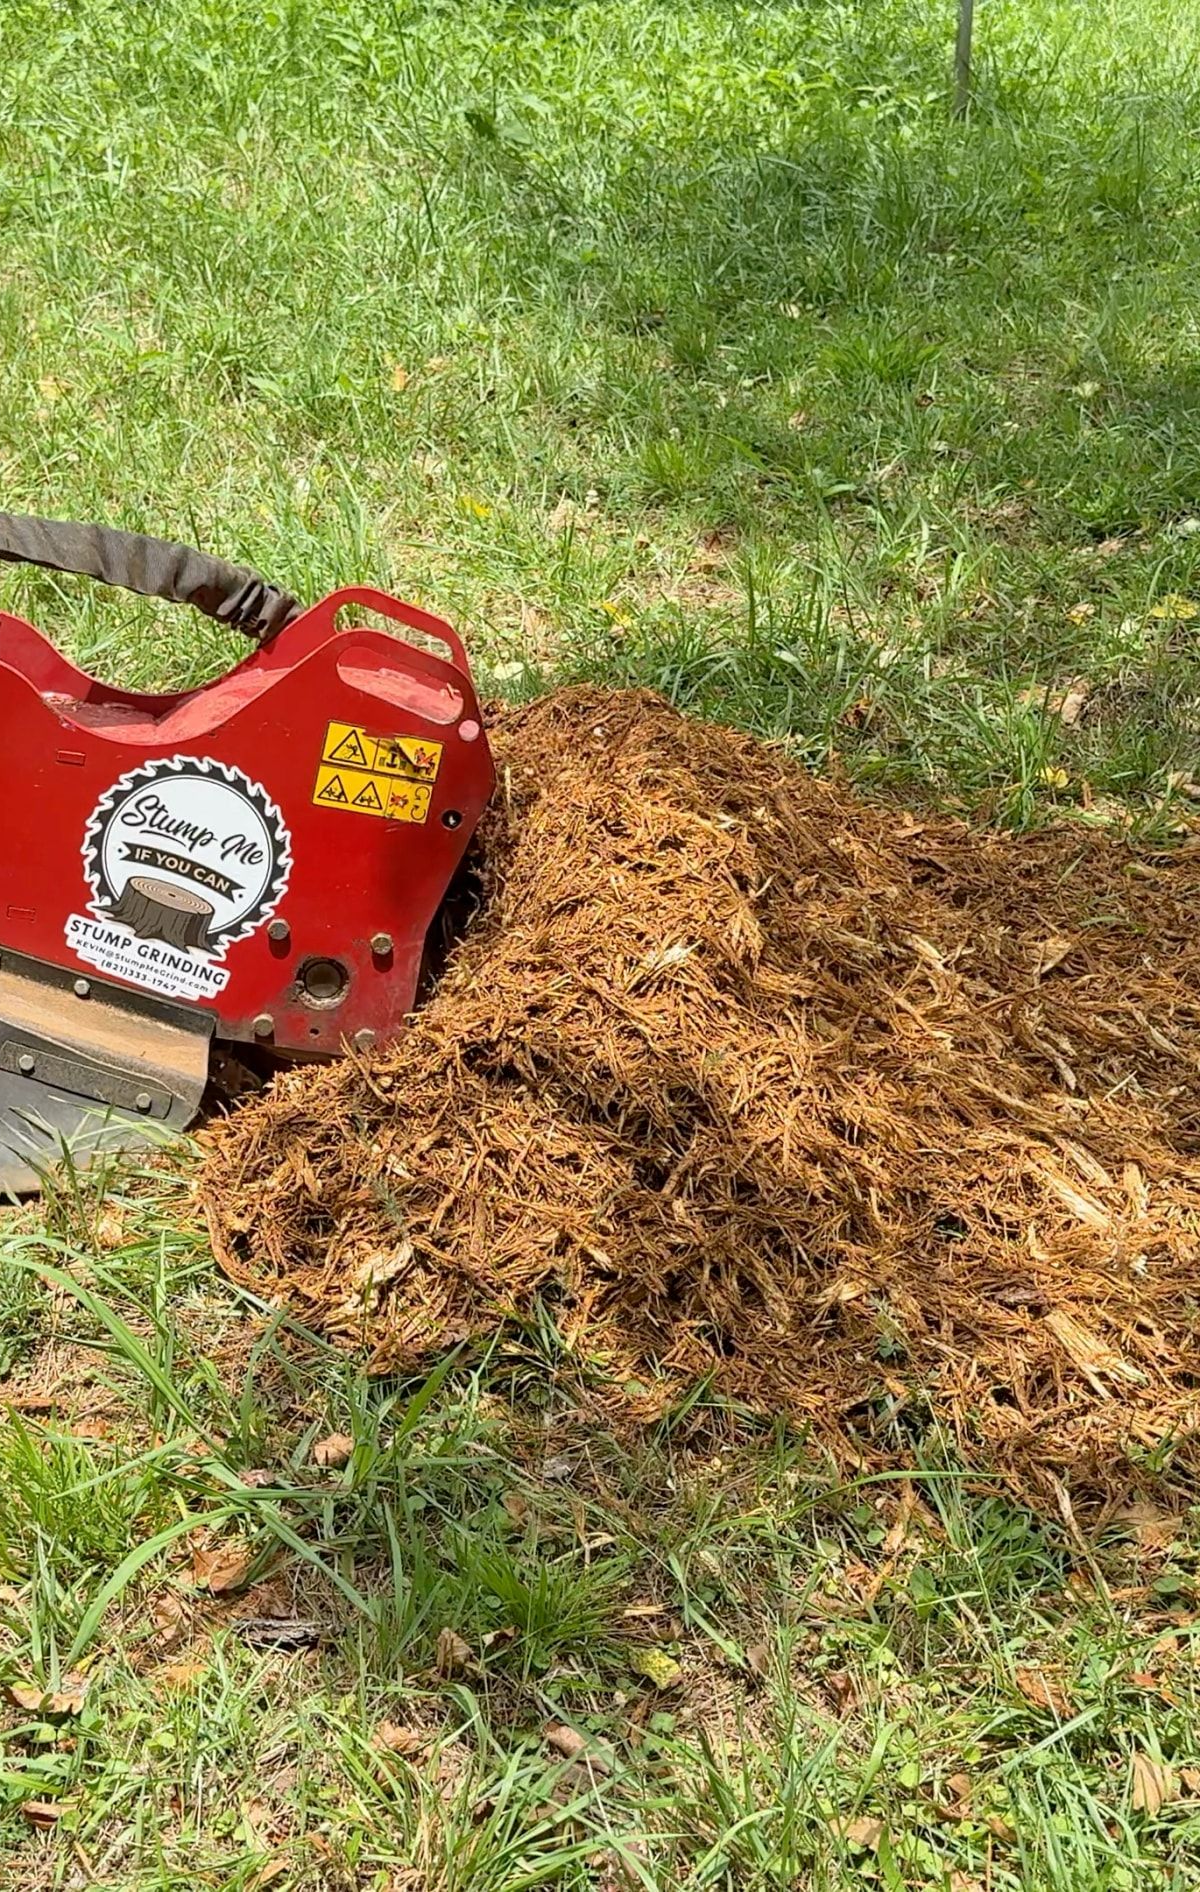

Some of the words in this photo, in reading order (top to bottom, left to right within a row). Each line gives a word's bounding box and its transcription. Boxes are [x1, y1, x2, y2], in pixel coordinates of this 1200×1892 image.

[121, 795, 217, 852] Stump
[220, 834, 264, 865] Me
[135, 848, 152, 861] IF
[155, 853, 191, 874] YOU
[193, 868, 230, 892] CAN
[70, 919, 132, 950] STUMP
[137, 944, 225, 986] GRINDING
